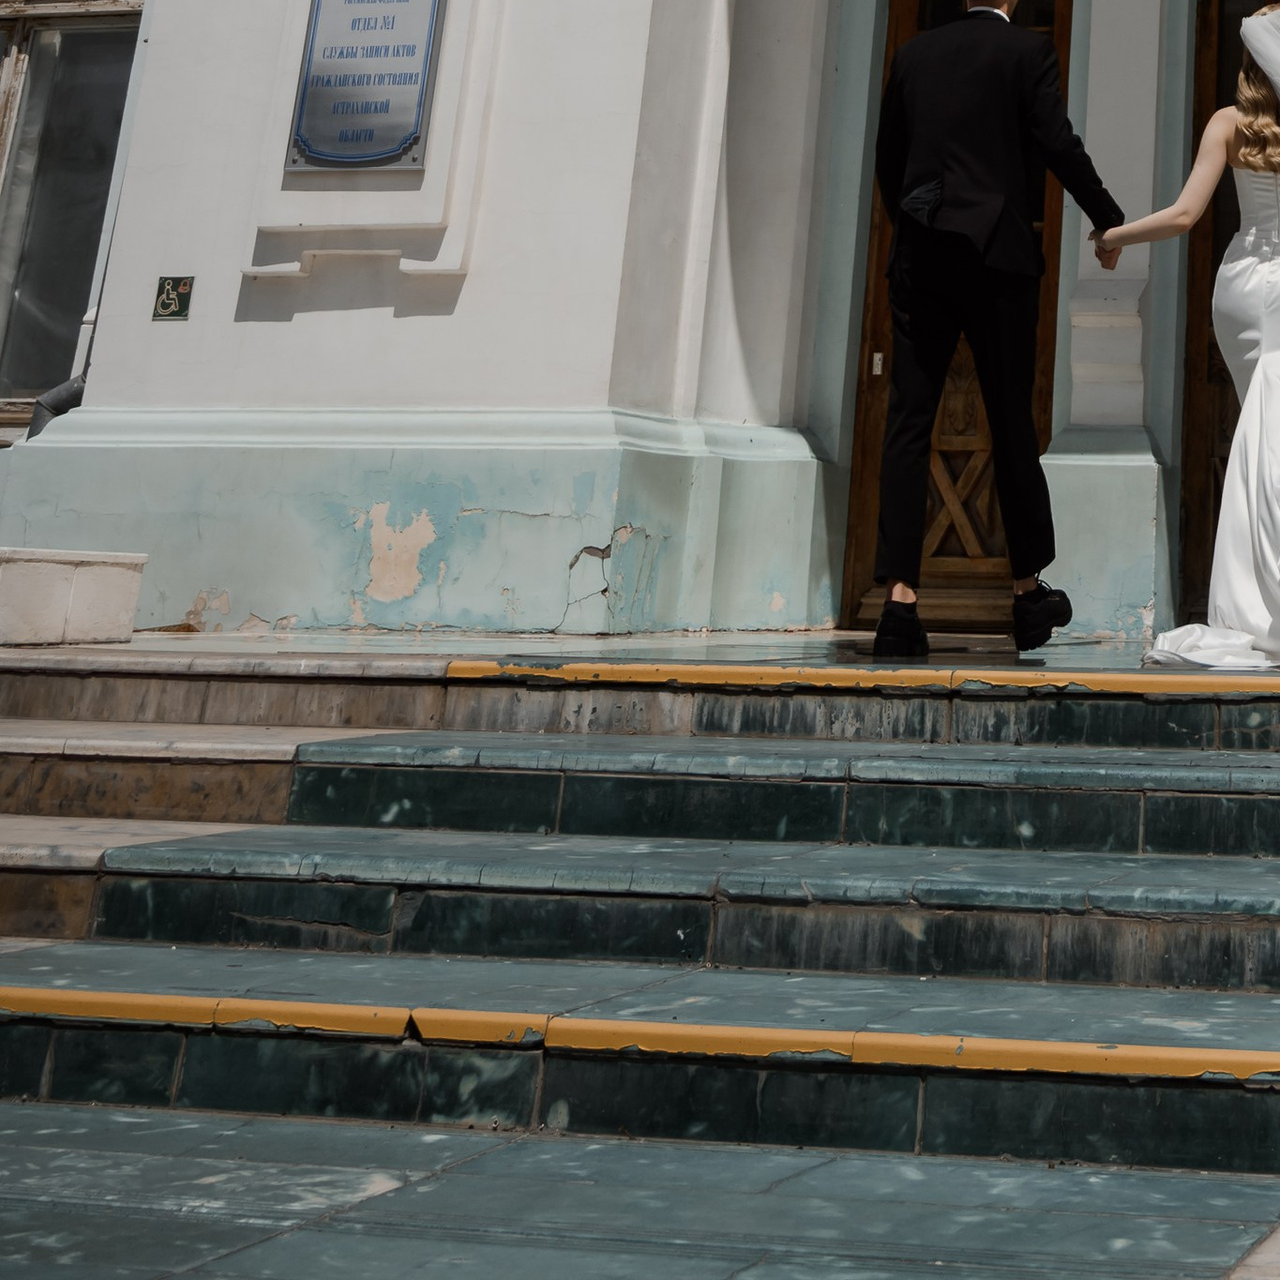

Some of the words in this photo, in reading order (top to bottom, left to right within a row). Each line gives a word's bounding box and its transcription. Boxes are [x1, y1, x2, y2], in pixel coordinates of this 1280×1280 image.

[350, 16, 378, 33] ОТДЕЛ
[380, 14, 396, 31] №1
[322, 45, 359, 60] СЛУЖБЫ
[359, 44, 391, 59] ЗАПИСИ
[391, 43, 417, 58] АКТОВ
[311, 73, 372, 89] ГРАЖДАНСКОГО
[373, 71, 420, 86] СОСТОЯНИЯ
[332, 98, 391, 115] АСТРАХАНСКОЙ
[338, 128, 375, 143] ОБЛАСТИ
